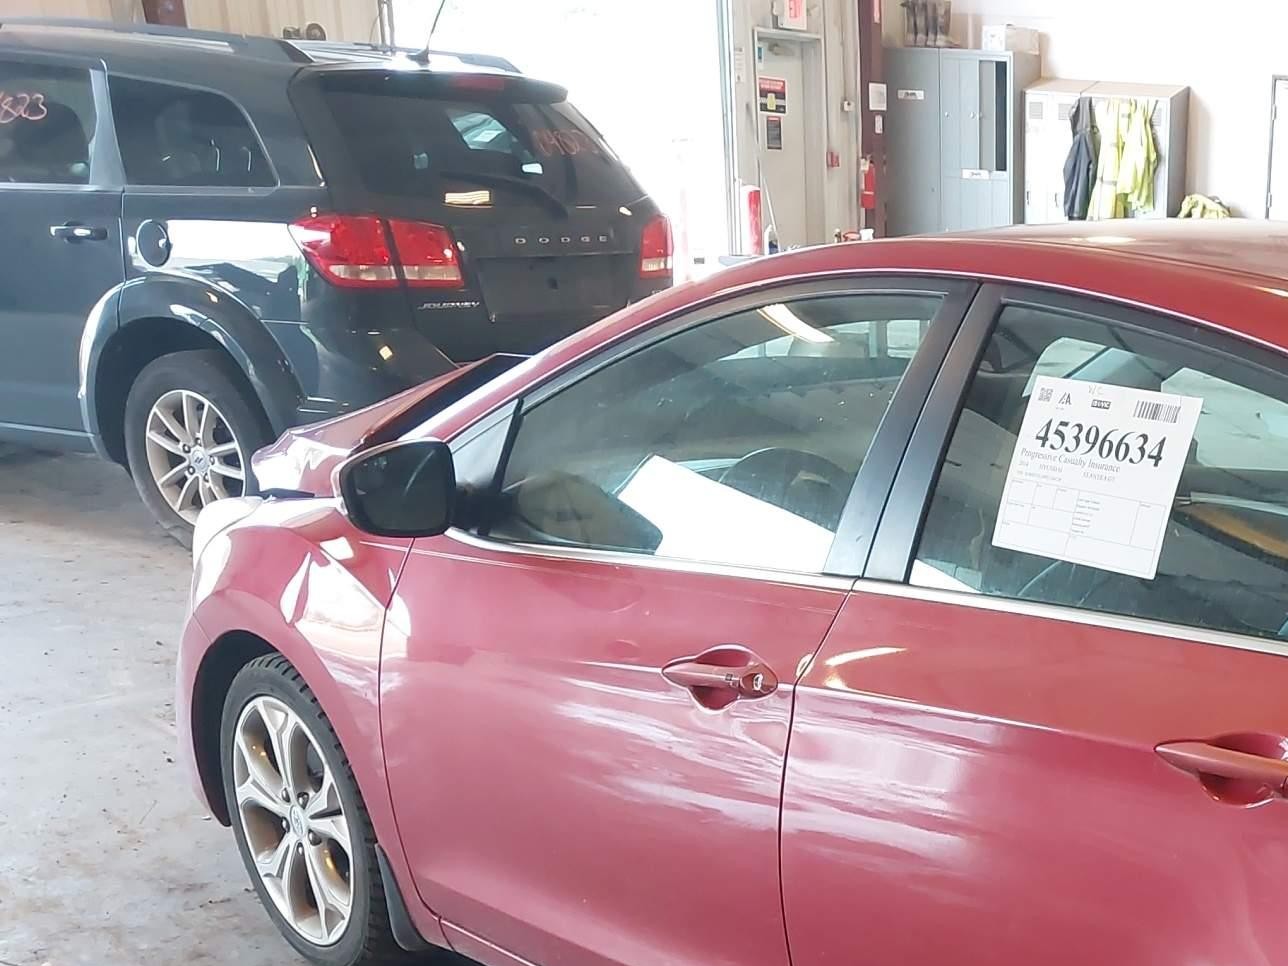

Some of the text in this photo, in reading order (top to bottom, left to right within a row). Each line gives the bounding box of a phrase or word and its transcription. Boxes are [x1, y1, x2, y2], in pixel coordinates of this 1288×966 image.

[514, 234, 608, 245] DODGE
[417, 301, 480, 310] JOURNEY
[1035, 418, 1166, 467] 45396634
[1021, 447, 1121, 473] Progressive Casualty Insurance
